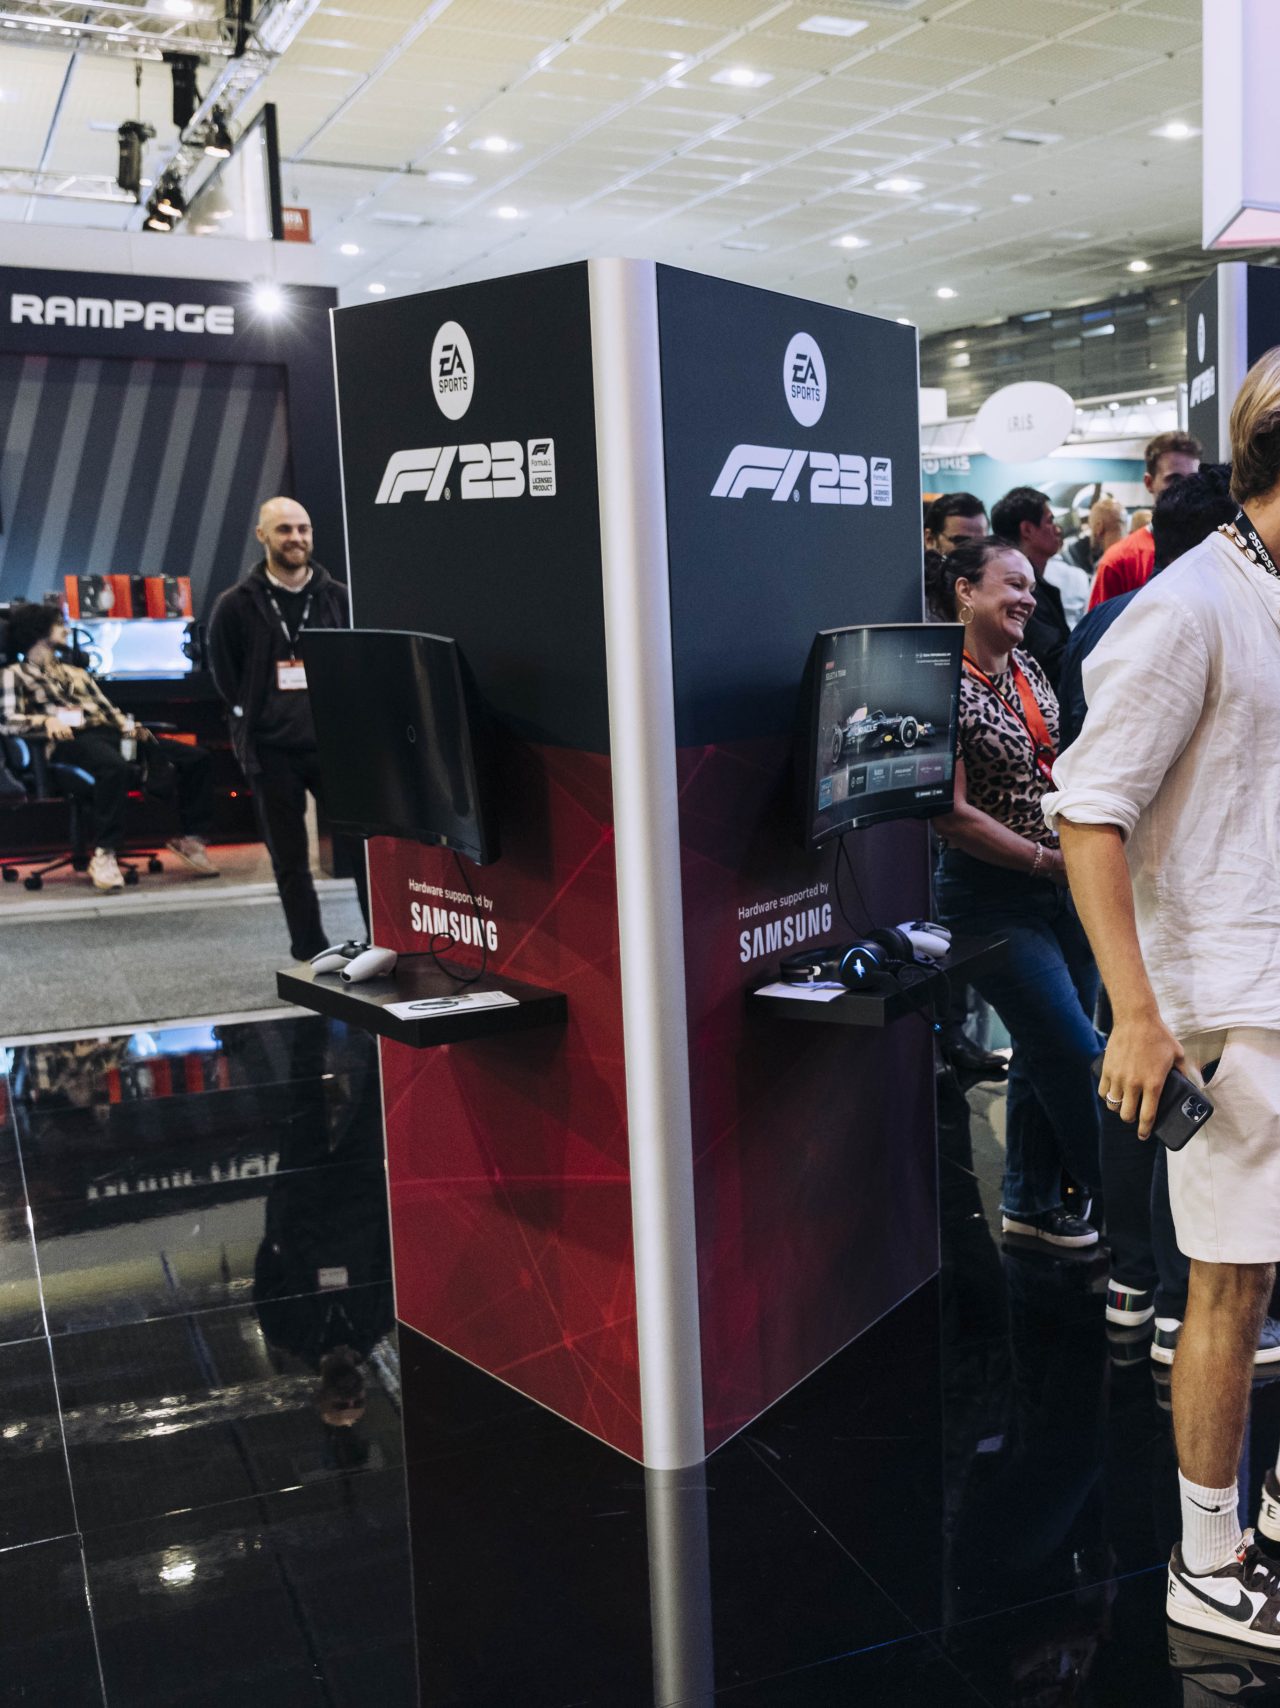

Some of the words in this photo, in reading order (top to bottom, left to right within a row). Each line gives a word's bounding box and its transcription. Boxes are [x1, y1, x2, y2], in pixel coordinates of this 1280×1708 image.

[11, 293, 235, 335] RAMPAGE
[438, 344, 466, 377] EA
[792, 353, 819, 386] EA
[438, 376, 468, 394] SPORTS
[791, 384, 821, 402] SPORTS
[459, 441, 526, 500] 23
[532, 477, 553, 485] LICENSED
[809, 451, 869, 506] 23
[532, 484, 553, 492] PRODUCT
[408, 878, 444, 898] Hardware
[444, 889, 483, 906] supportd
[483, 896, 494, 912] by
[738, 899, 778, 920] Hardware
[779, 884, 819, 907] supported
[819, 882, 829, 895] by
[410, 901, 499, 952] SAMSUNG
[739, 902, 832, 963] SAMSUNG
[1235, 1542, 1248, 1555] NIKE
